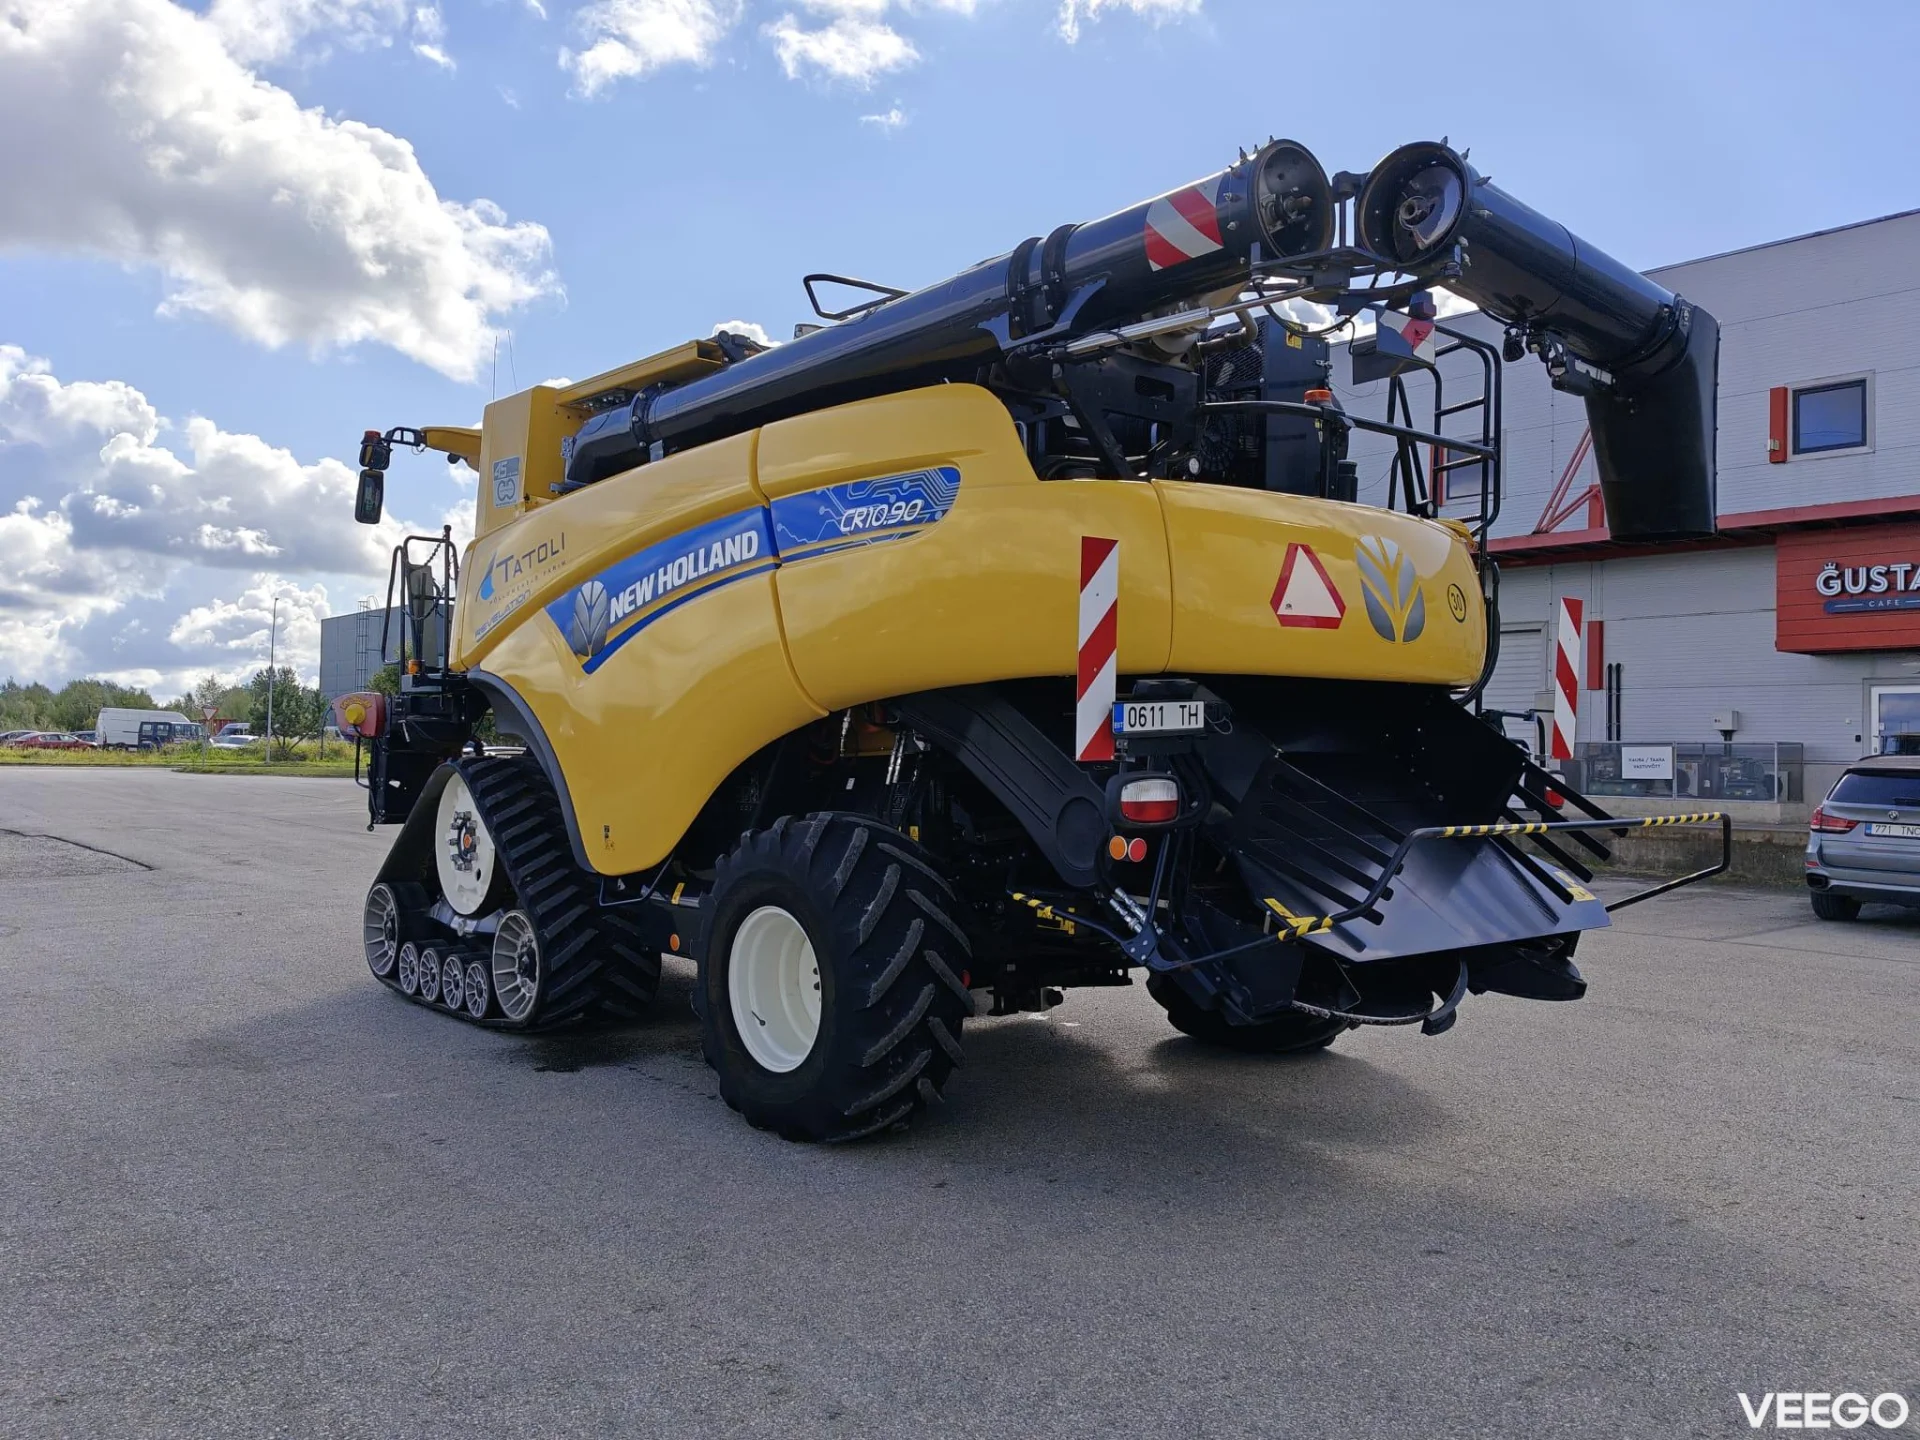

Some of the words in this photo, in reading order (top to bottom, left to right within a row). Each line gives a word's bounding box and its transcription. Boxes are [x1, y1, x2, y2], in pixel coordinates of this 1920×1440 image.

[840, 499, 924, 532] CR10.90
[496, 531, 565, 583] TATOLI
[609, 572, 655, 624] NEW
[657, 530, 759, 595] HOLLAND
[1450, 592, 1463, 612] 30
[1128, 705, 1164, 728] 0611
[1179, 704, 1199, 726] TH
